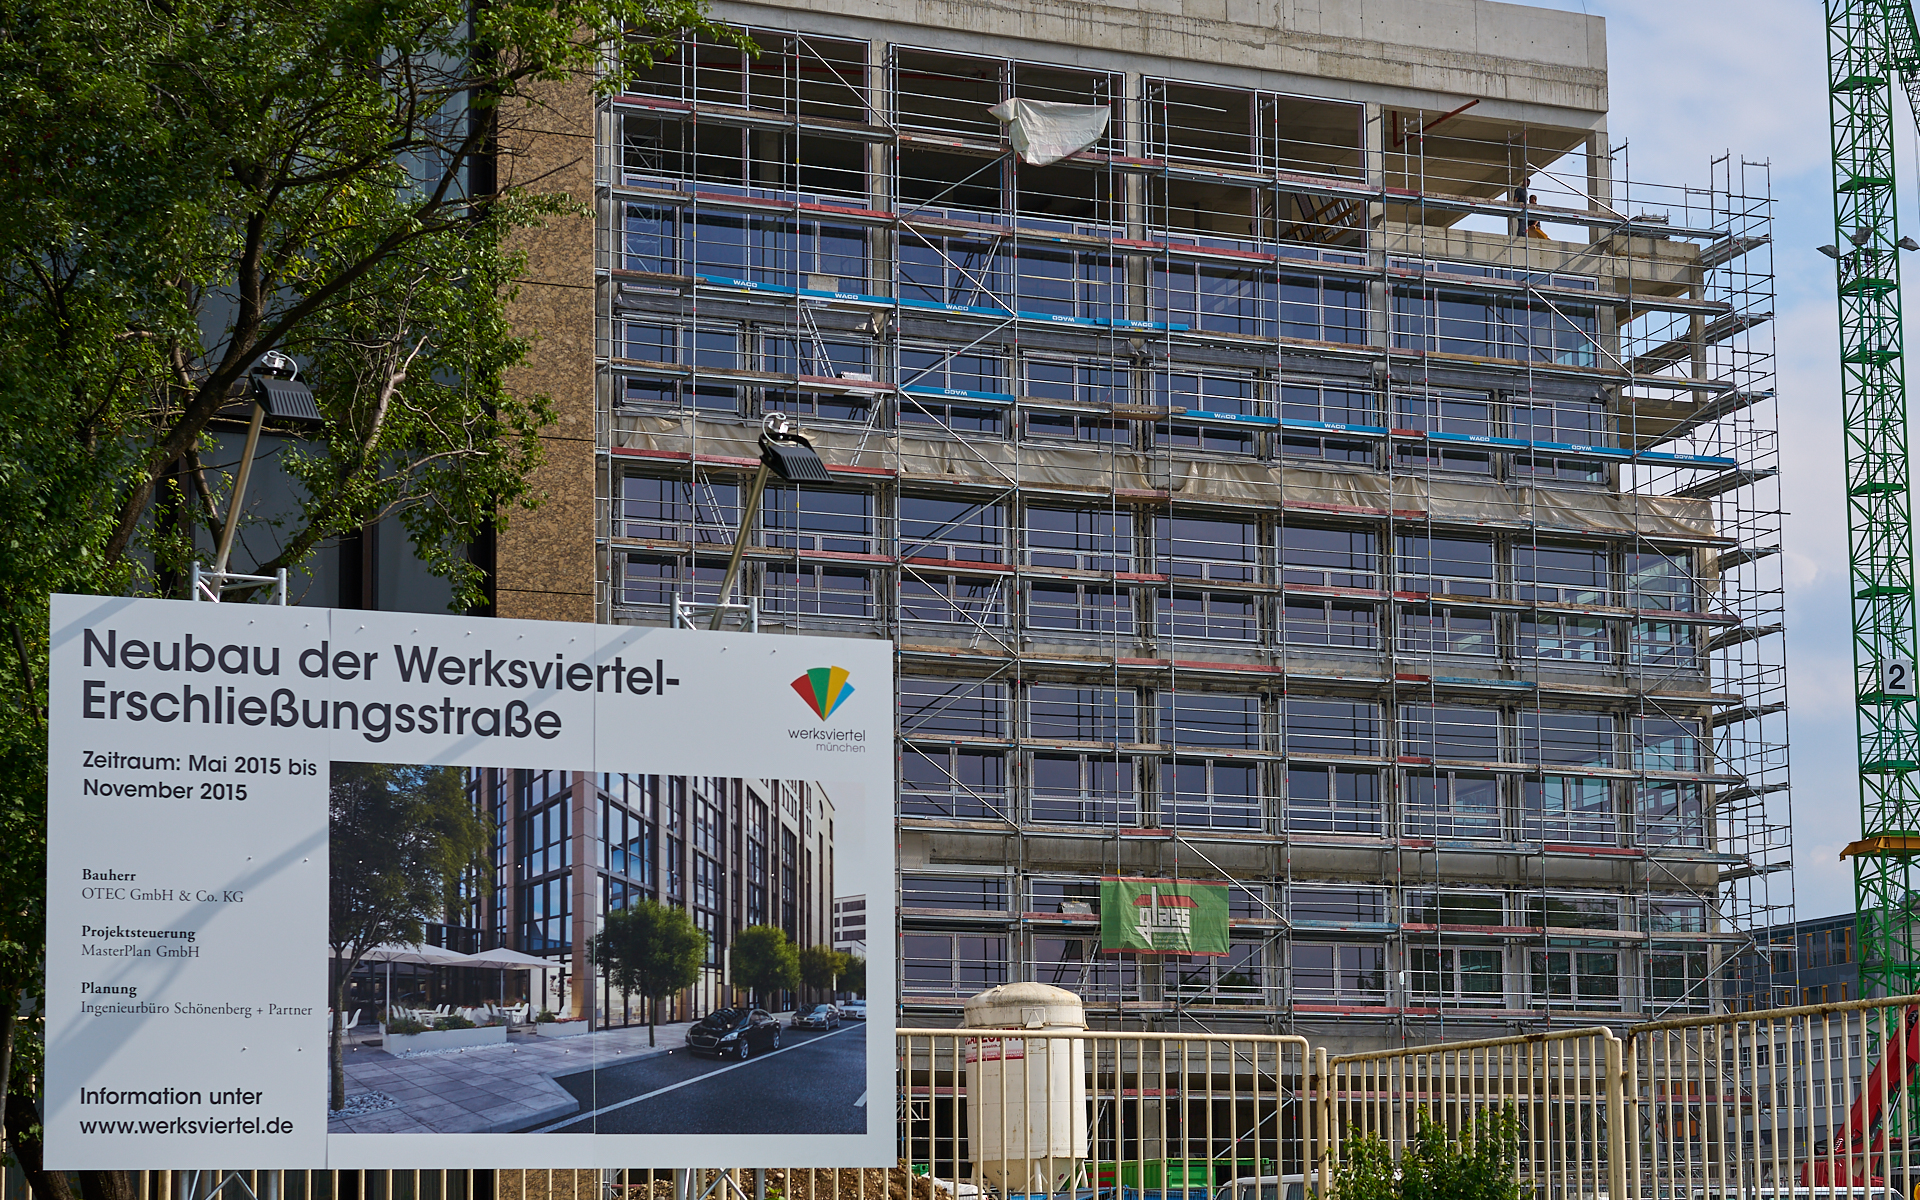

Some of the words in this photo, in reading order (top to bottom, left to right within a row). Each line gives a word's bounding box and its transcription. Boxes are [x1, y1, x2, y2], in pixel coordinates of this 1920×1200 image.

[734, 279, 758, 287] WACO
[835, 292, 859, 300] WACO
[945, 303, 969, 311] WACO
[1051, 315, 1075, 323] WACO
[944, 388, 968, 396] WACO
[1324, 422, 1346, 430] WACO
[83, 628, 279, 675] Neubau
[299, 641, 378, 680] der
[393, 645, 680, 696] Werksviertel-
[1888, 664, 1906, 690] 2
[82, 679, 562, 743] Erschließungsstraße
[788, 728, 866, 740] werksviertel
[816, 742, 866, 753] münchen
[83, 751, 180, 770] Zeitraum:
[189, 755, 226, 772] Mai
[235, 757, 281, 774] 2015
[289, 759, 316, 775] bis
[84, 779, 193, 798] November
[201, 783, 247, 800] 2015
[83, 869, 136, 880] Bauherr
[82, 888, 124, 899] OTEC
[131, 889, 172, 900] GmbH
[179, 891, 190, 901] &
[196, 891, 217, 901] Co.
[224, 891, 243, 902] KG
[1135, 886, 1190, 945] glass
[82, 926, 195, 942] Projektsteuerung
[82, 945, 150, 956] MasterPlan
[157, 946, 198, 957] GmbH
[82, 982, 136, 998] Planung
[82, 1002, 169, 1016] Ingenieurbüro
[175, 1002, 251, 1018] Schönenberg
[256, 1007, 264, 1015] +
[270, 1004, 312, 1015] Partner
[81, 1087, 201, 1104] Information
[210, 1088, 262, 1104] unter
[80, 1117, 293, 1134] www.werksviertel.de
